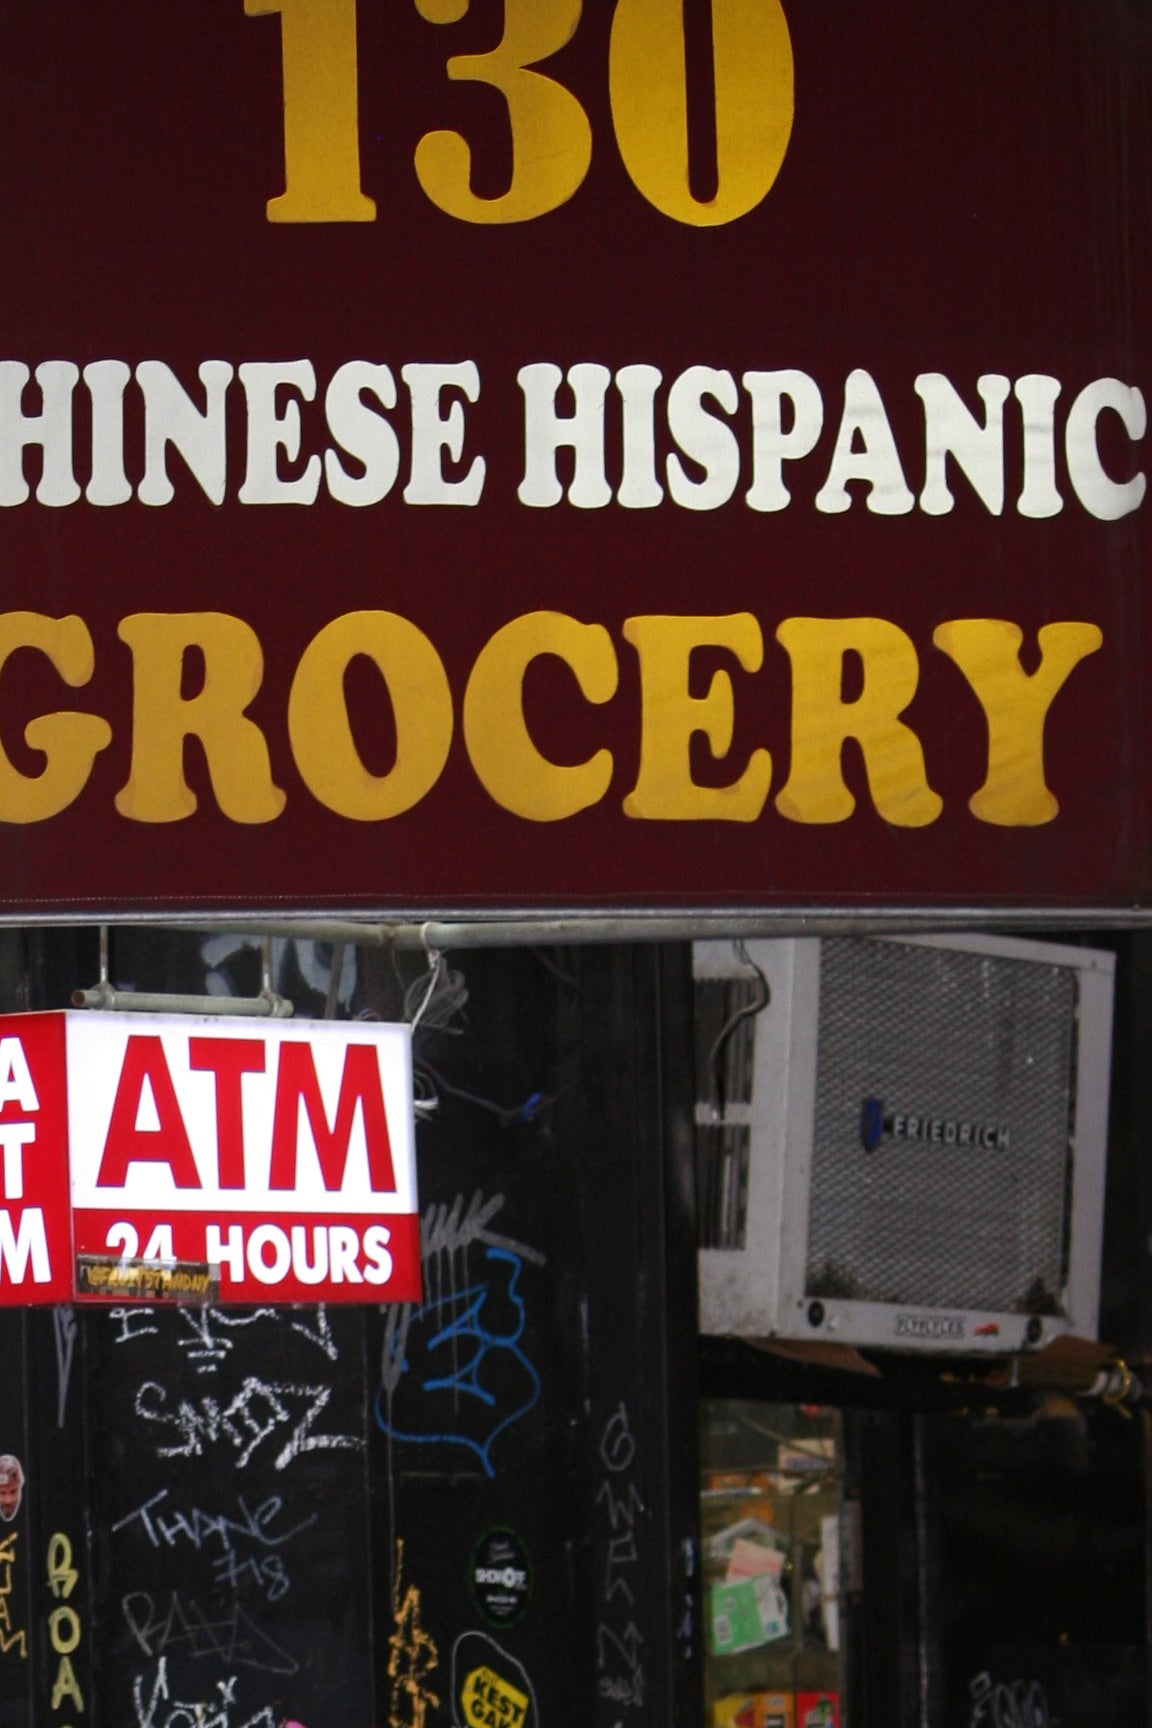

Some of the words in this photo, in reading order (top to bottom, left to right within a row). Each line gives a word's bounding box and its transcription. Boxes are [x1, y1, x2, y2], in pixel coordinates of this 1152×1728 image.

[244, 0, 795, 227] 130
[516, 362, 1148, 520] HISPANIC
[94, 1033, 399, 1194] ATM
[891, 1116, 1010, 1149] FRIEDRICH
[205, 1223, 393, 1285] HOURS
